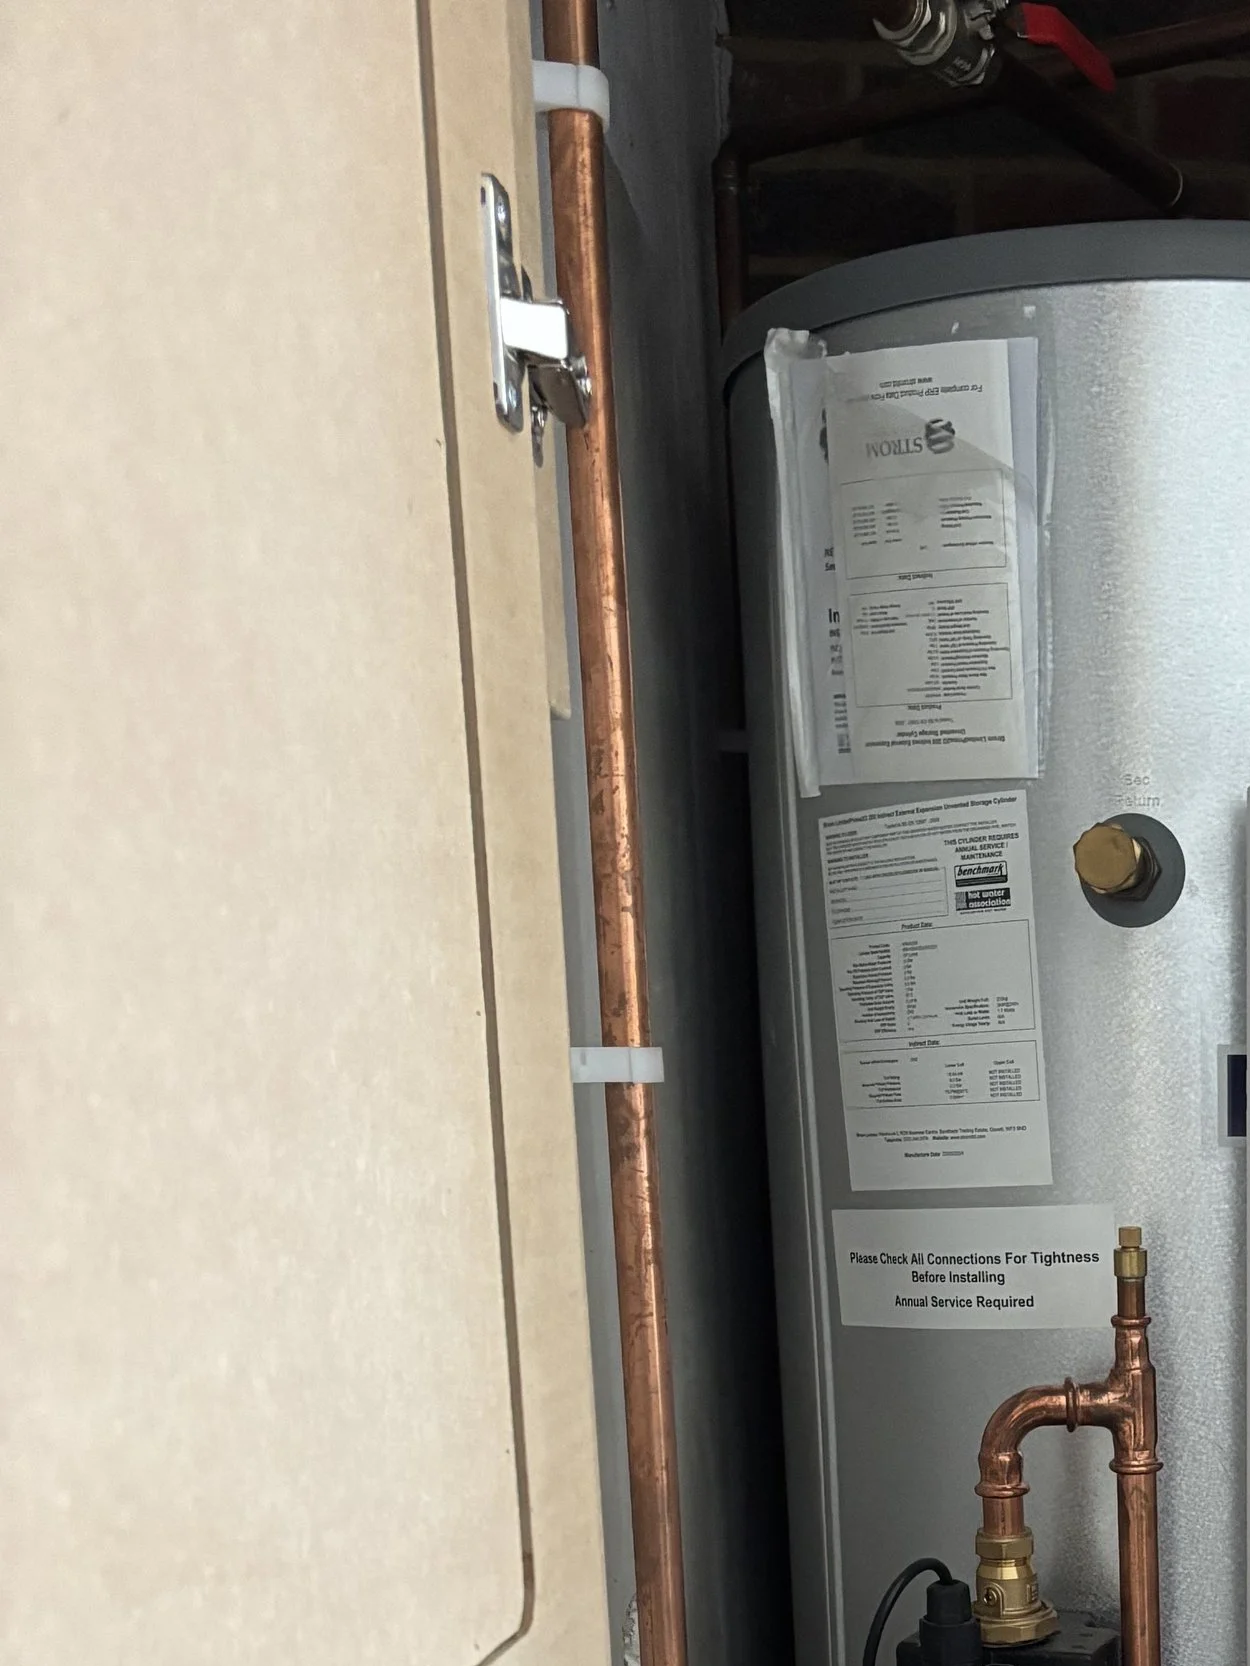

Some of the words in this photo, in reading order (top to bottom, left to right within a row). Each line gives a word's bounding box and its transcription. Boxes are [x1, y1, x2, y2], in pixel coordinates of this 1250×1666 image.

[865, 436, 923, 459] STROM
[956, 863, 1005, 877] benchmark
[967, 891, 981, 899] hot
[981, 889, 1006, 898] water
[968, 898, 1011, 909] association
[849, 1251, 879, 1265] Please
[879, 1252, 909, 1266] Check
[910, 1253, 924, 1266] All
[926, 1252, 1001, 1265] Connections
[1005, 1252, 1027, 1265] For
[1030, 1251, 1100, 1267] Tightness
[911, 1270, 946, 1283] Before
[949, 1270, 1006, 1286] Installing
[895, 1295, 928, 1308] Annual
[930, 1295, 973, 1308] Service
[976, 1295, 1035, 1311] Required
